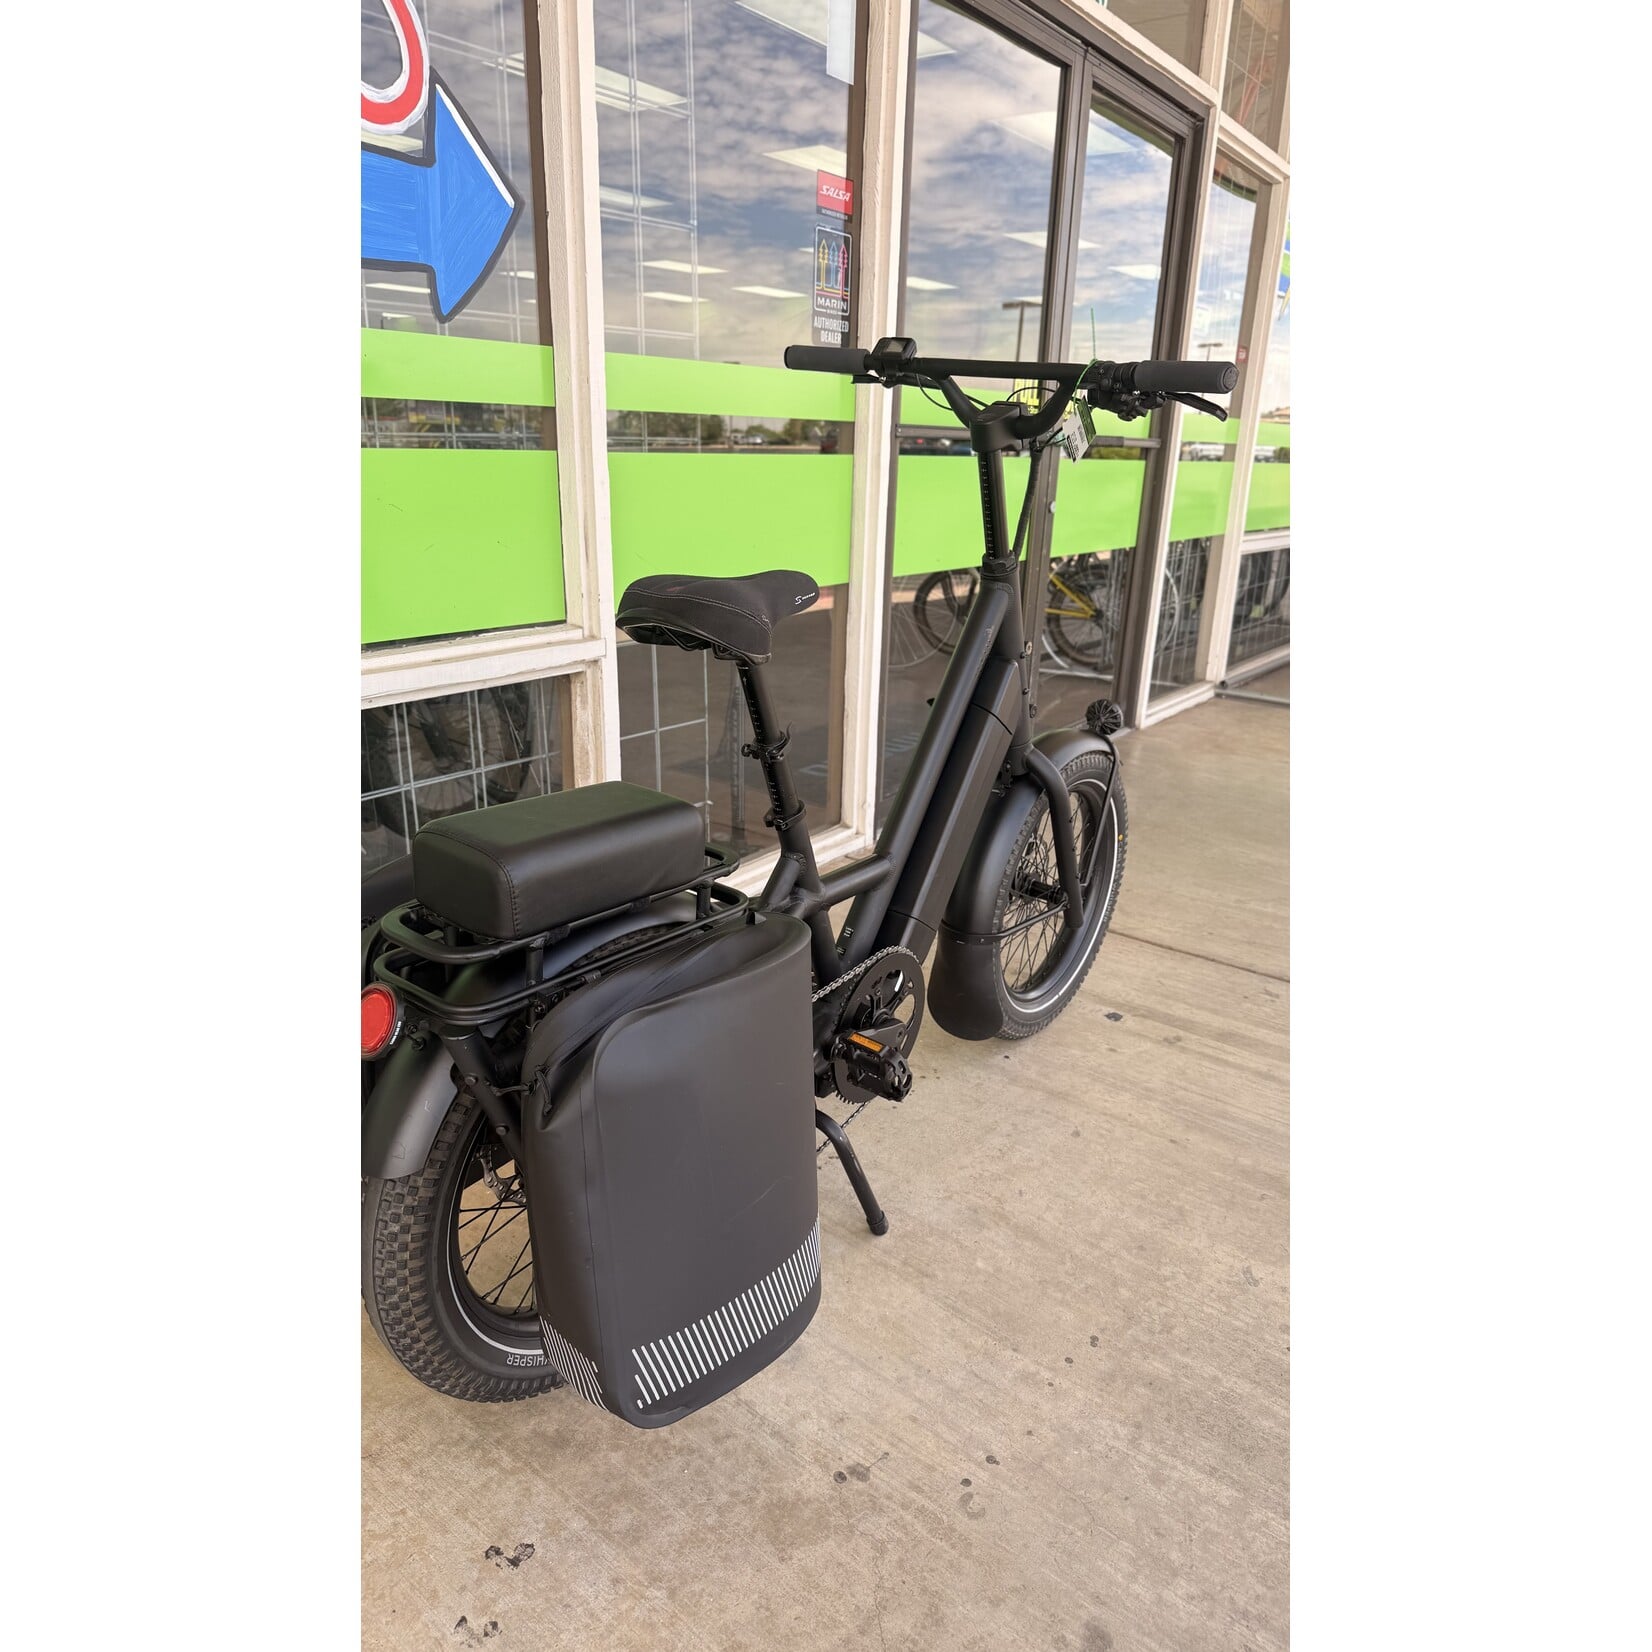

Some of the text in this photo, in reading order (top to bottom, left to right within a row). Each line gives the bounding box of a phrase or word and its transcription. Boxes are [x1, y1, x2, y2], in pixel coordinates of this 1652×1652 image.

[819, 185, 851, 202] SALSA
[817, 296, 847, 311] MARIN
[813, 316, 849, 332] AUTHORIZED
[820, 330, 842, 344] DEALER
[506, 1353, 548, 1367] HISPER
